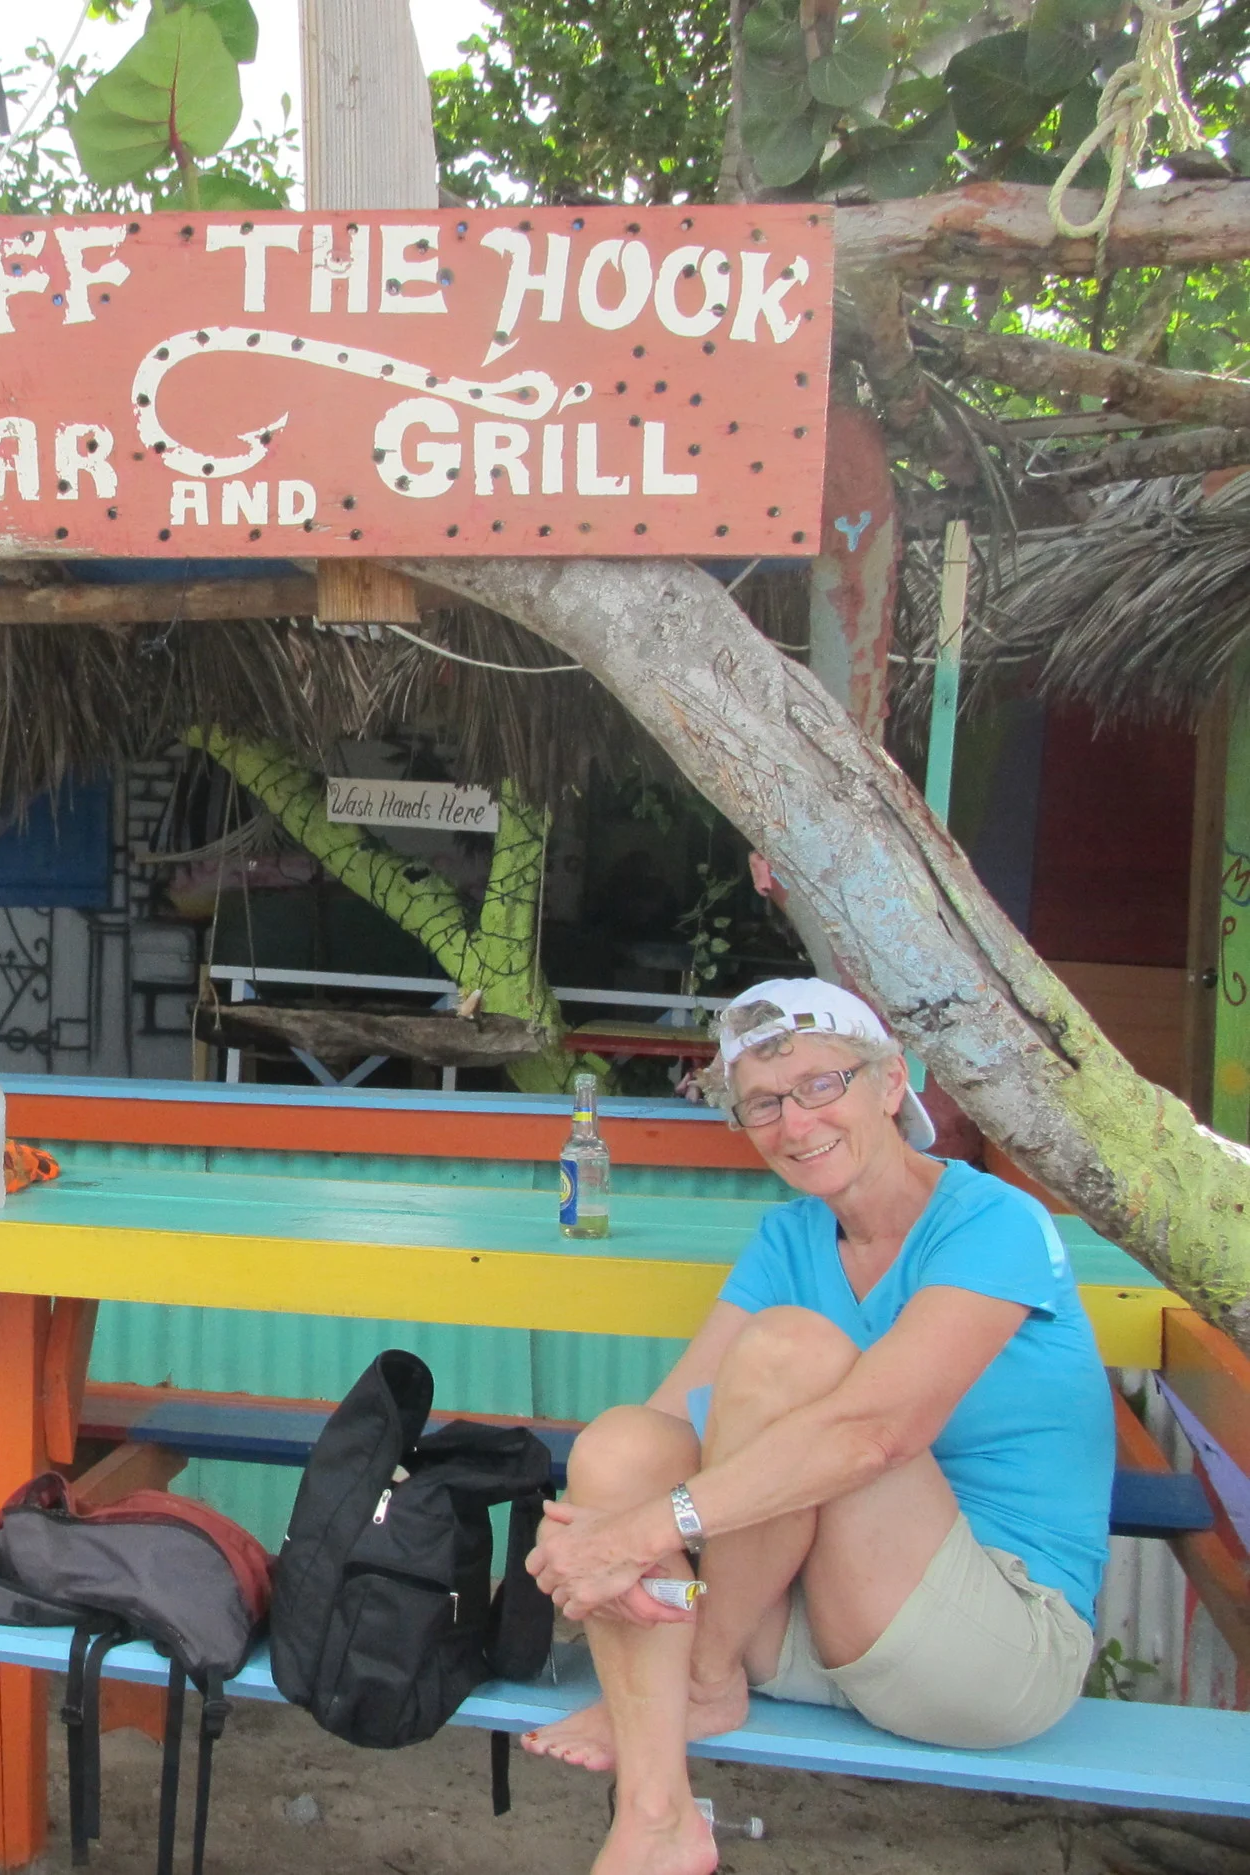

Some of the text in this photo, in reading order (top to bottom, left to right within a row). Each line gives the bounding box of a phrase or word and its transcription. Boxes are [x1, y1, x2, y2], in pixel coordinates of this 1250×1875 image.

[205, 223, 450, 314] THE
[481, 227, 810, 367] HOOK
[169, 478, 317, 526] AND
[372, 398, 698, 498] GRILL
[327, 783, 486, 826] Wash Hands Here
